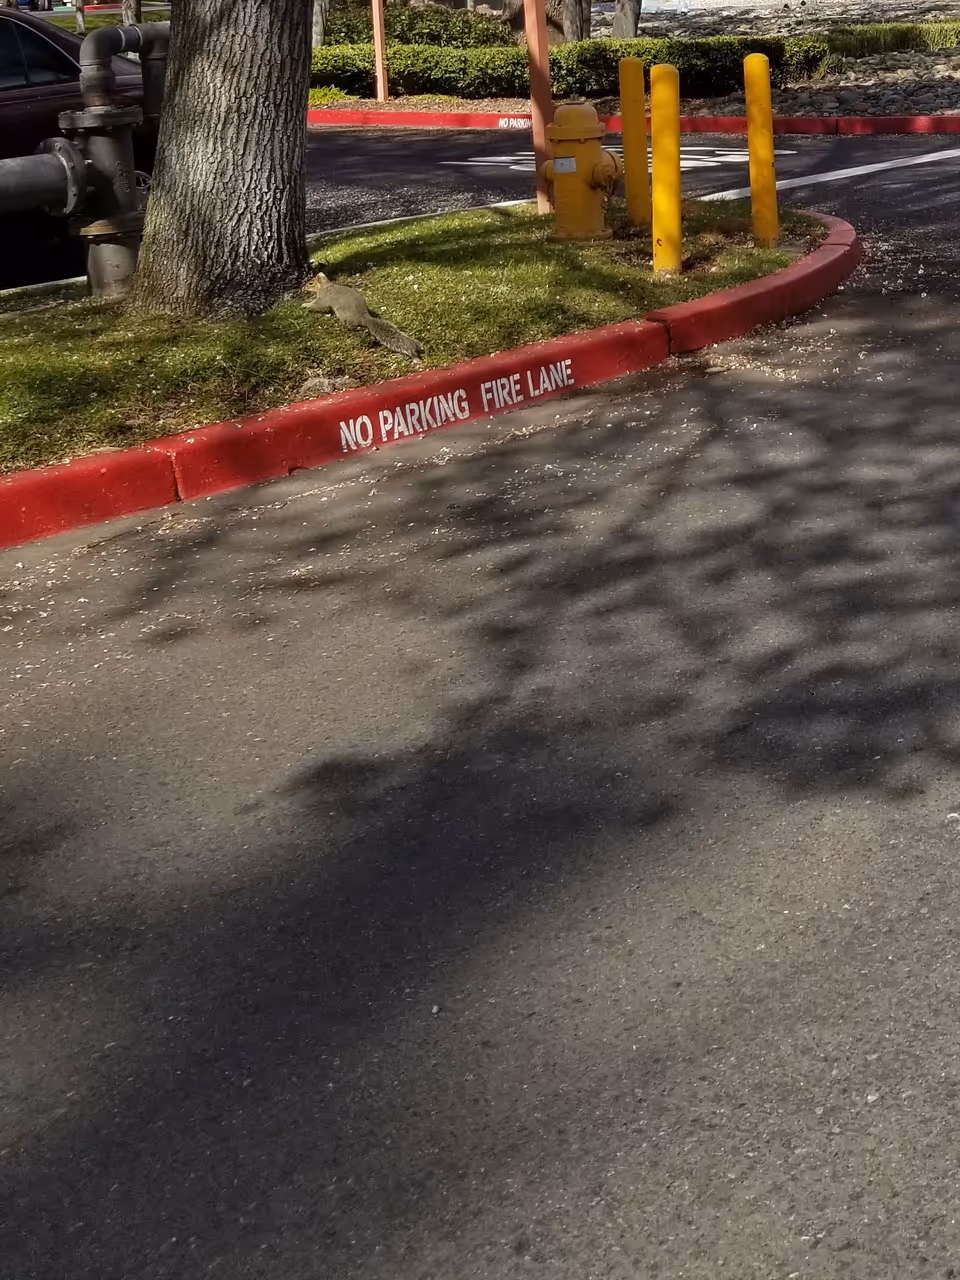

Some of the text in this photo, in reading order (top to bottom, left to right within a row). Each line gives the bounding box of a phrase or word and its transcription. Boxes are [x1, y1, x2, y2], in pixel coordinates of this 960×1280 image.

[498, 118, 532, 129] NO PARKIN
[339, 358, 575, 453] NO PARKING FIRE LANE
